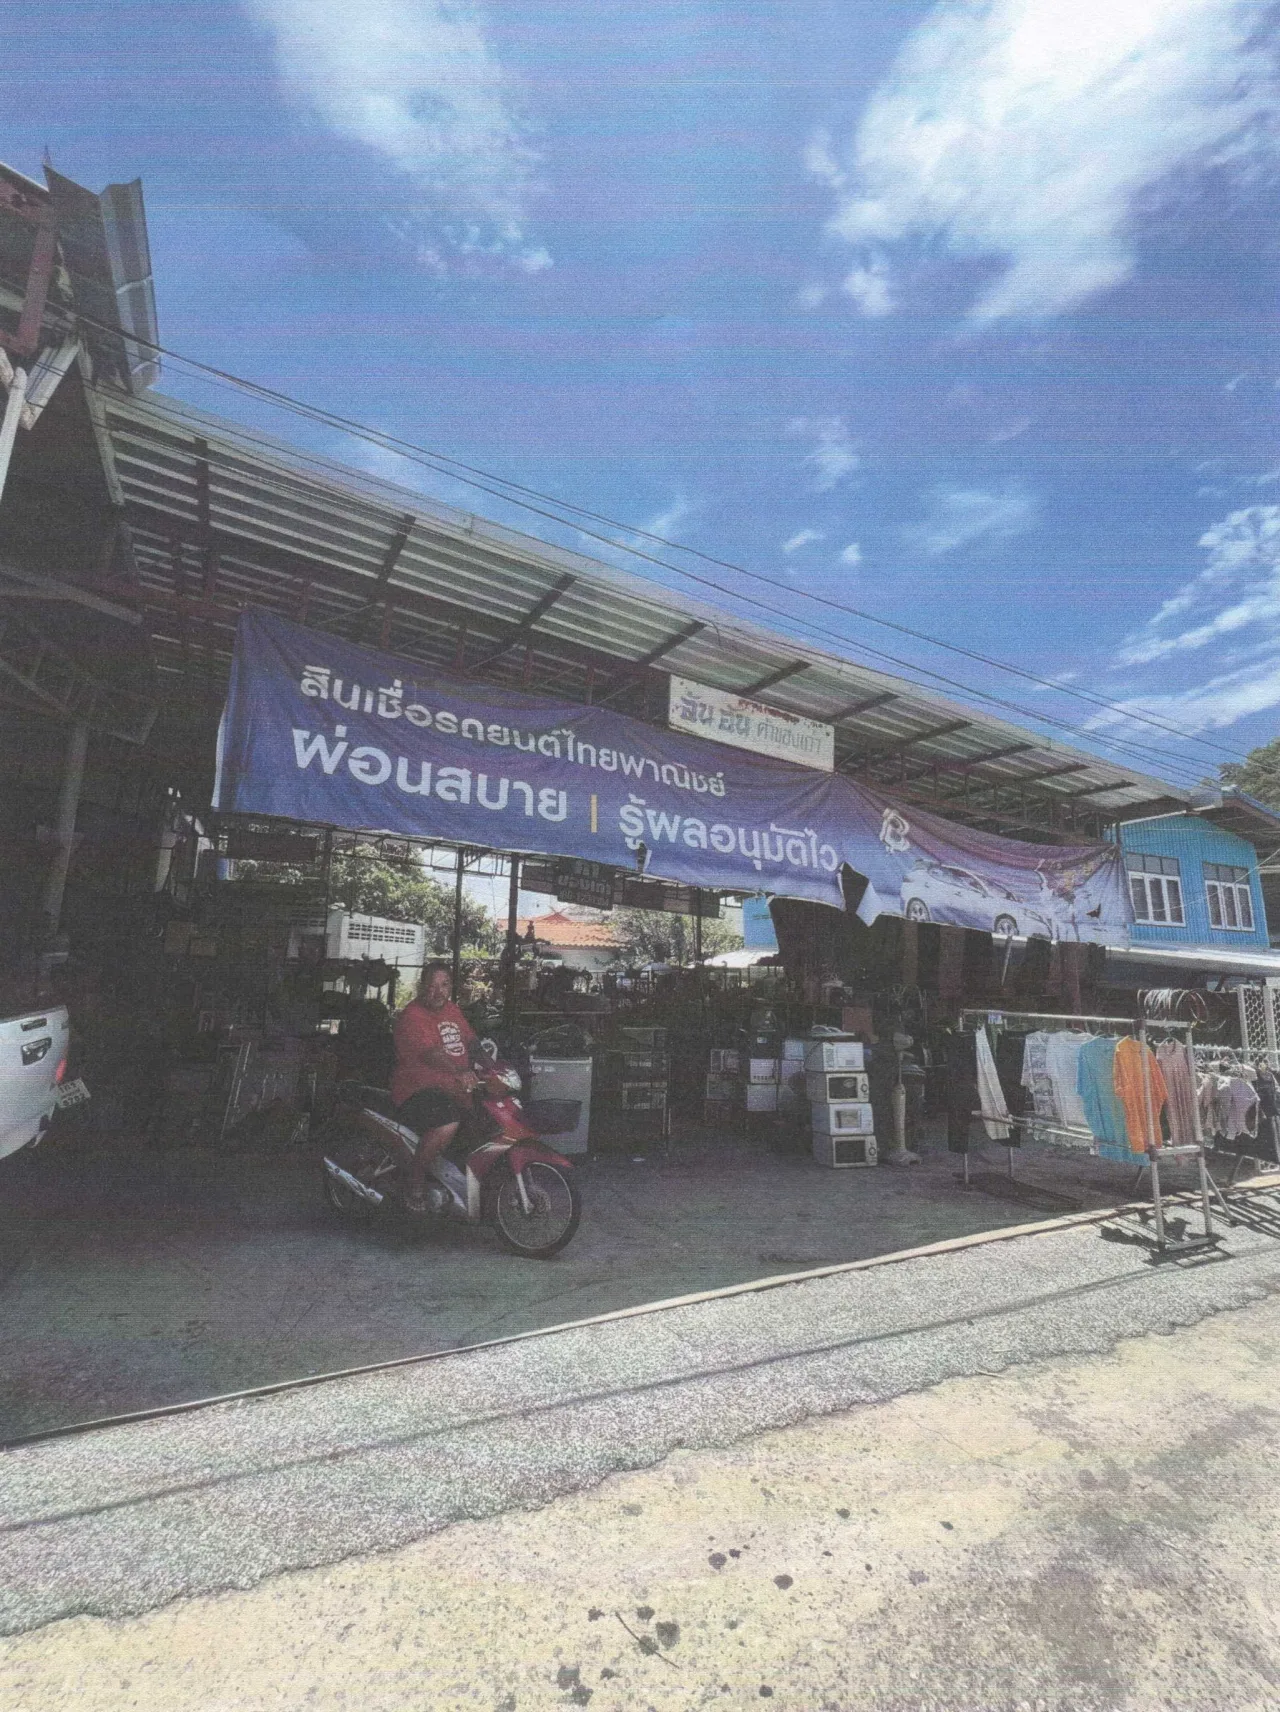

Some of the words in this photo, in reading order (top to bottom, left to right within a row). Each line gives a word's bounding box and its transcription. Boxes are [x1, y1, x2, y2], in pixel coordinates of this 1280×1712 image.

[292, 724, 568, 822] ผ่อนสบาย
[618, 792, 839, 872] รู้ผลอนุมัติไว
[300, 664, 727, 797] สินเชื่อรถยนต์ไทยพาณิชย์
